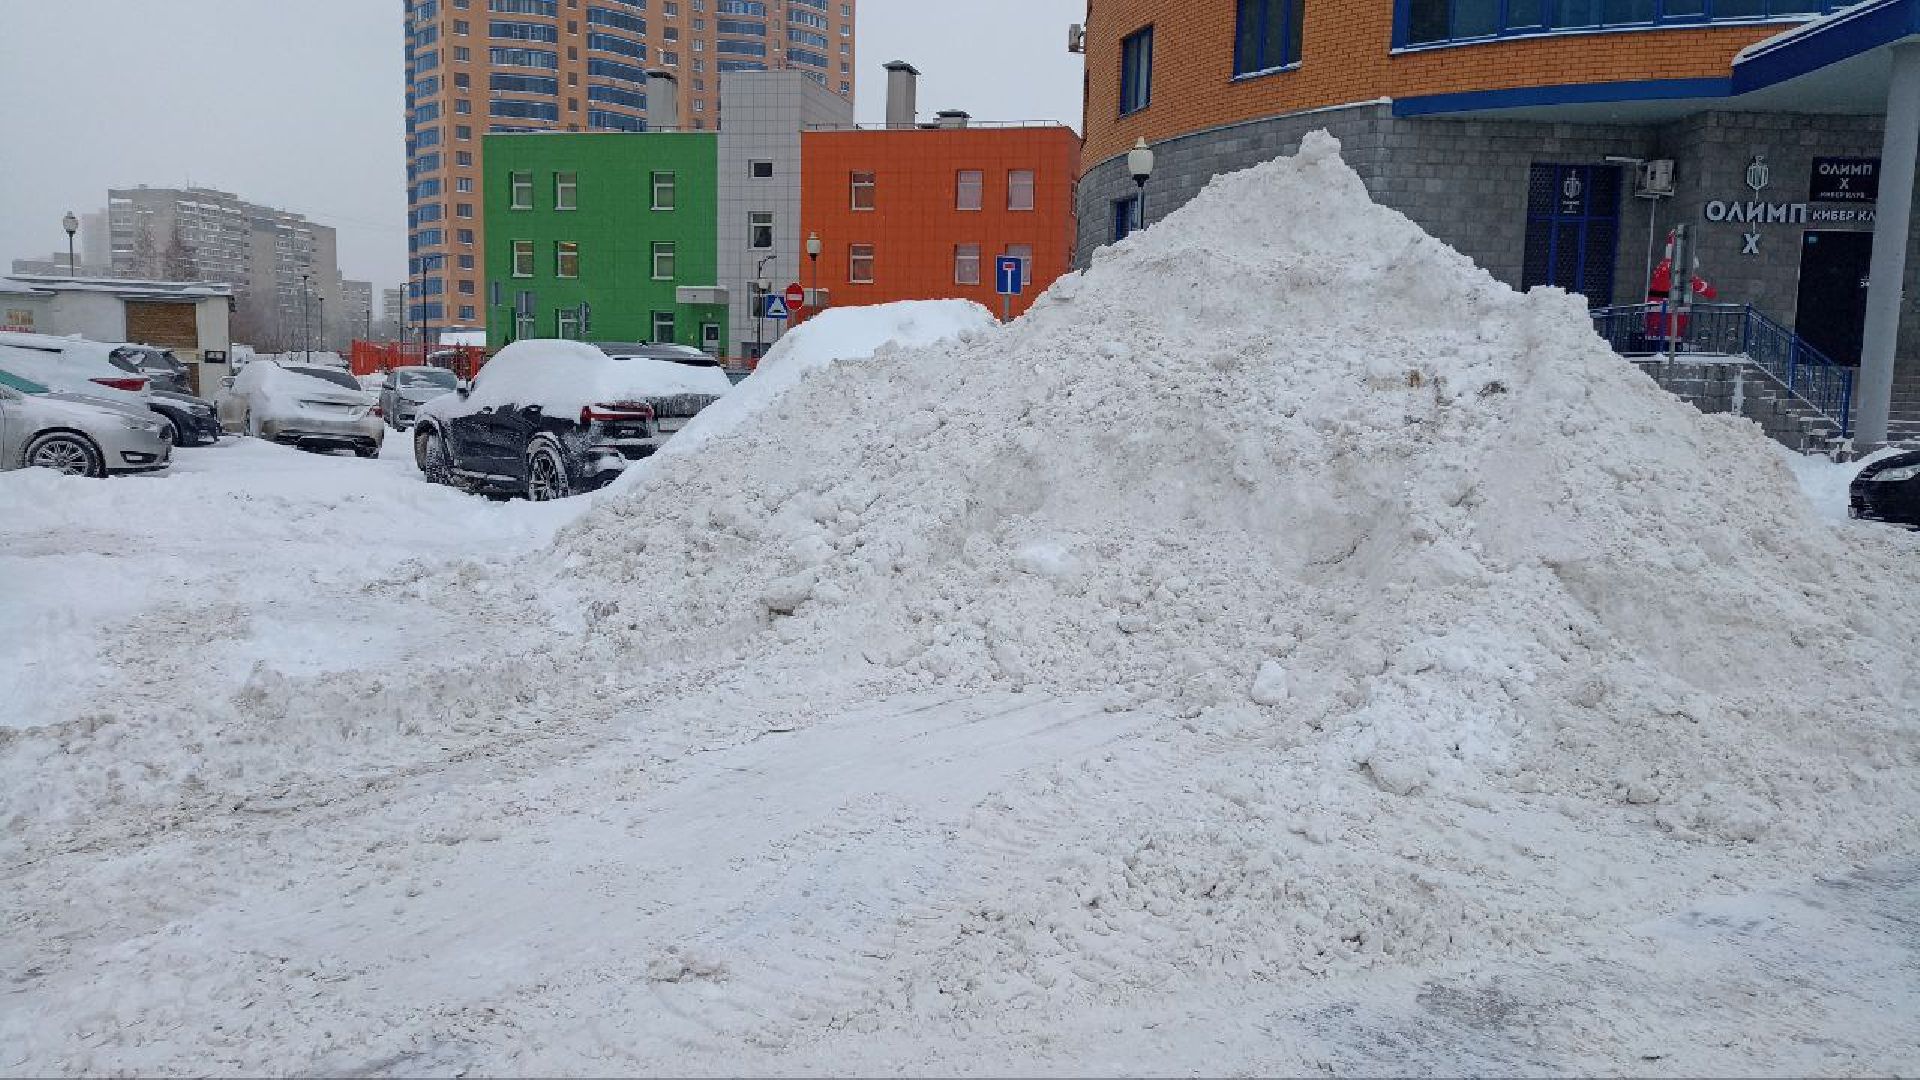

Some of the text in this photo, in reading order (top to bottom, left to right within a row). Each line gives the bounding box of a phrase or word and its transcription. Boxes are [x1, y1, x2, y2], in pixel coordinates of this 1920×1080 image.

[1819, 163, 1873, 175] ОЛИМП
[1706, 201, 1807, 223] ОЛИМП
[1813, 210, 1876, 221] КИБЕР КЛ
